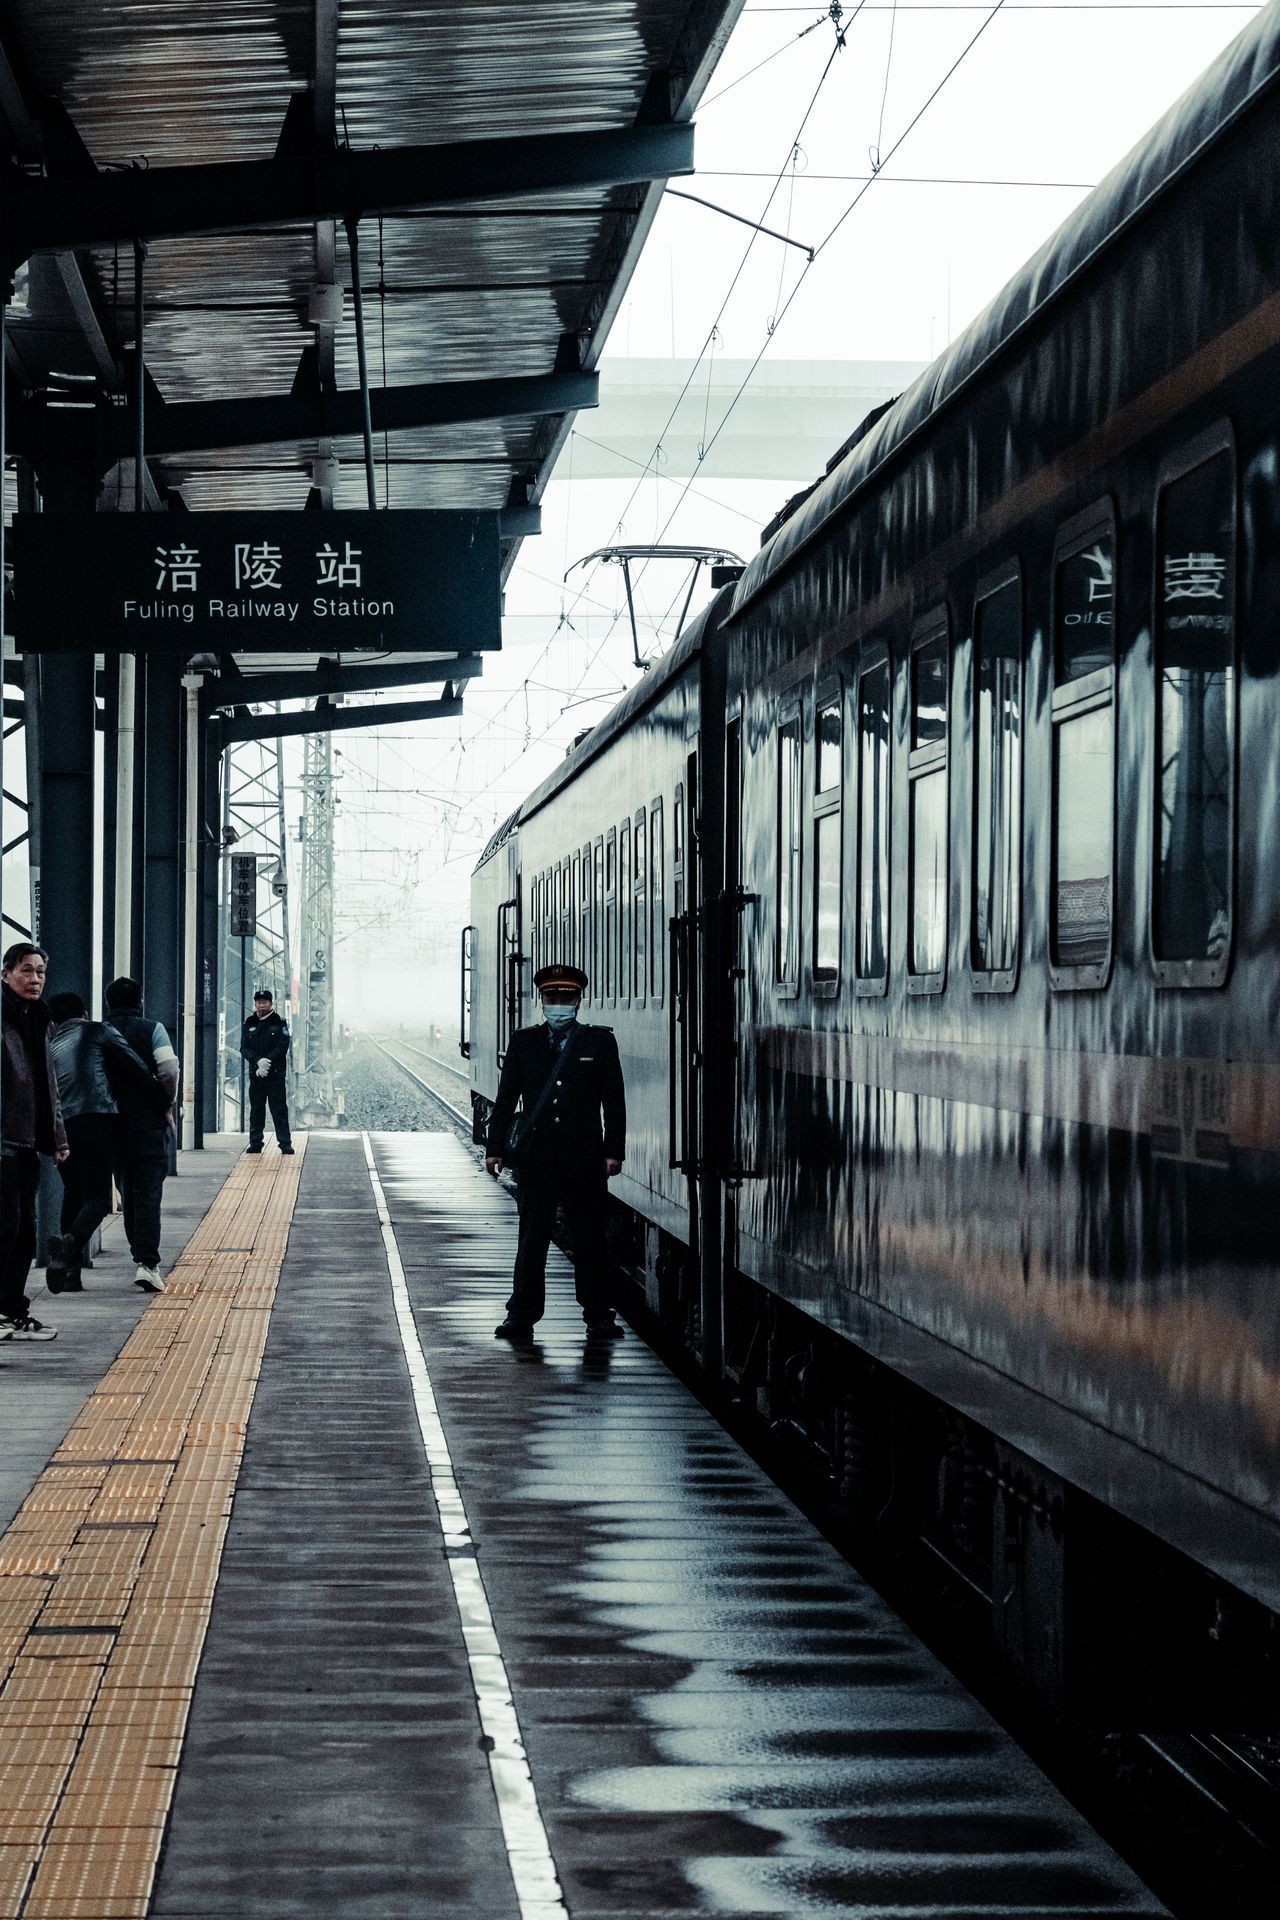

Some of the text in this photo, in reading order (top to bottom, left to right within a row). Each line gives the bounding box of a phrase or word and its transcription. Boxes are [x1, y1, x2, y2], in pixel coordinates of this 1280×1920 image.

[154, 541, 362, 592] 涪陵站
[124, 598, 394, 622] Fuling Railway Station
[238, 857, 250, 932] 机车停车位置
